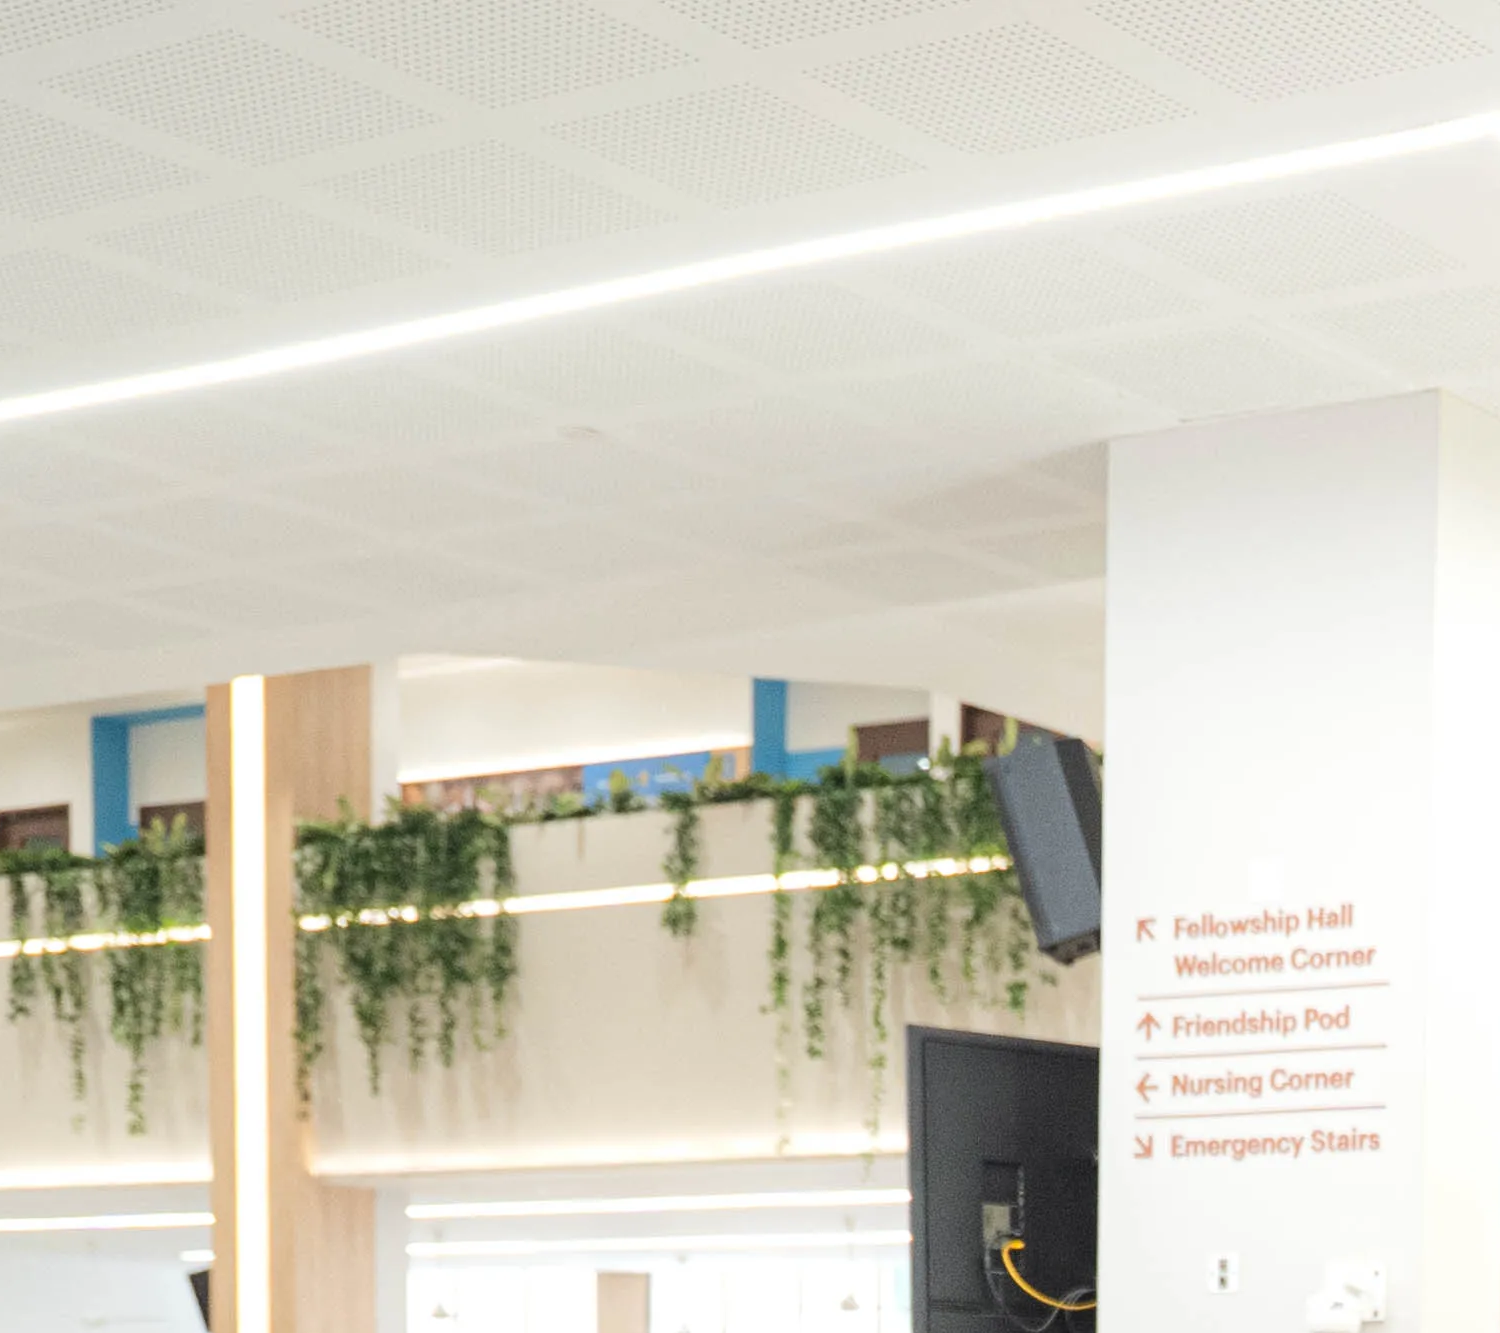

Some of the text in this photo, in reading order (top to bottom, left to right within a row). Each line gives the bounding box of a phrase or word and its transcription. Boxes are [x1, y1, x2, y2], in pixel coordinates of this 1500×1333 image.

[1173, 902, 1354, 938] Fellowship Hall
[1174, 945, 1377, 977] Welcome Corner
[1172, 1004, 1350, 1038] Friendship Pod
[1171, 1067, 1355, 1098] Nursing Corner
[1169, 1127, 1380, 1162] Emergency Stairs
